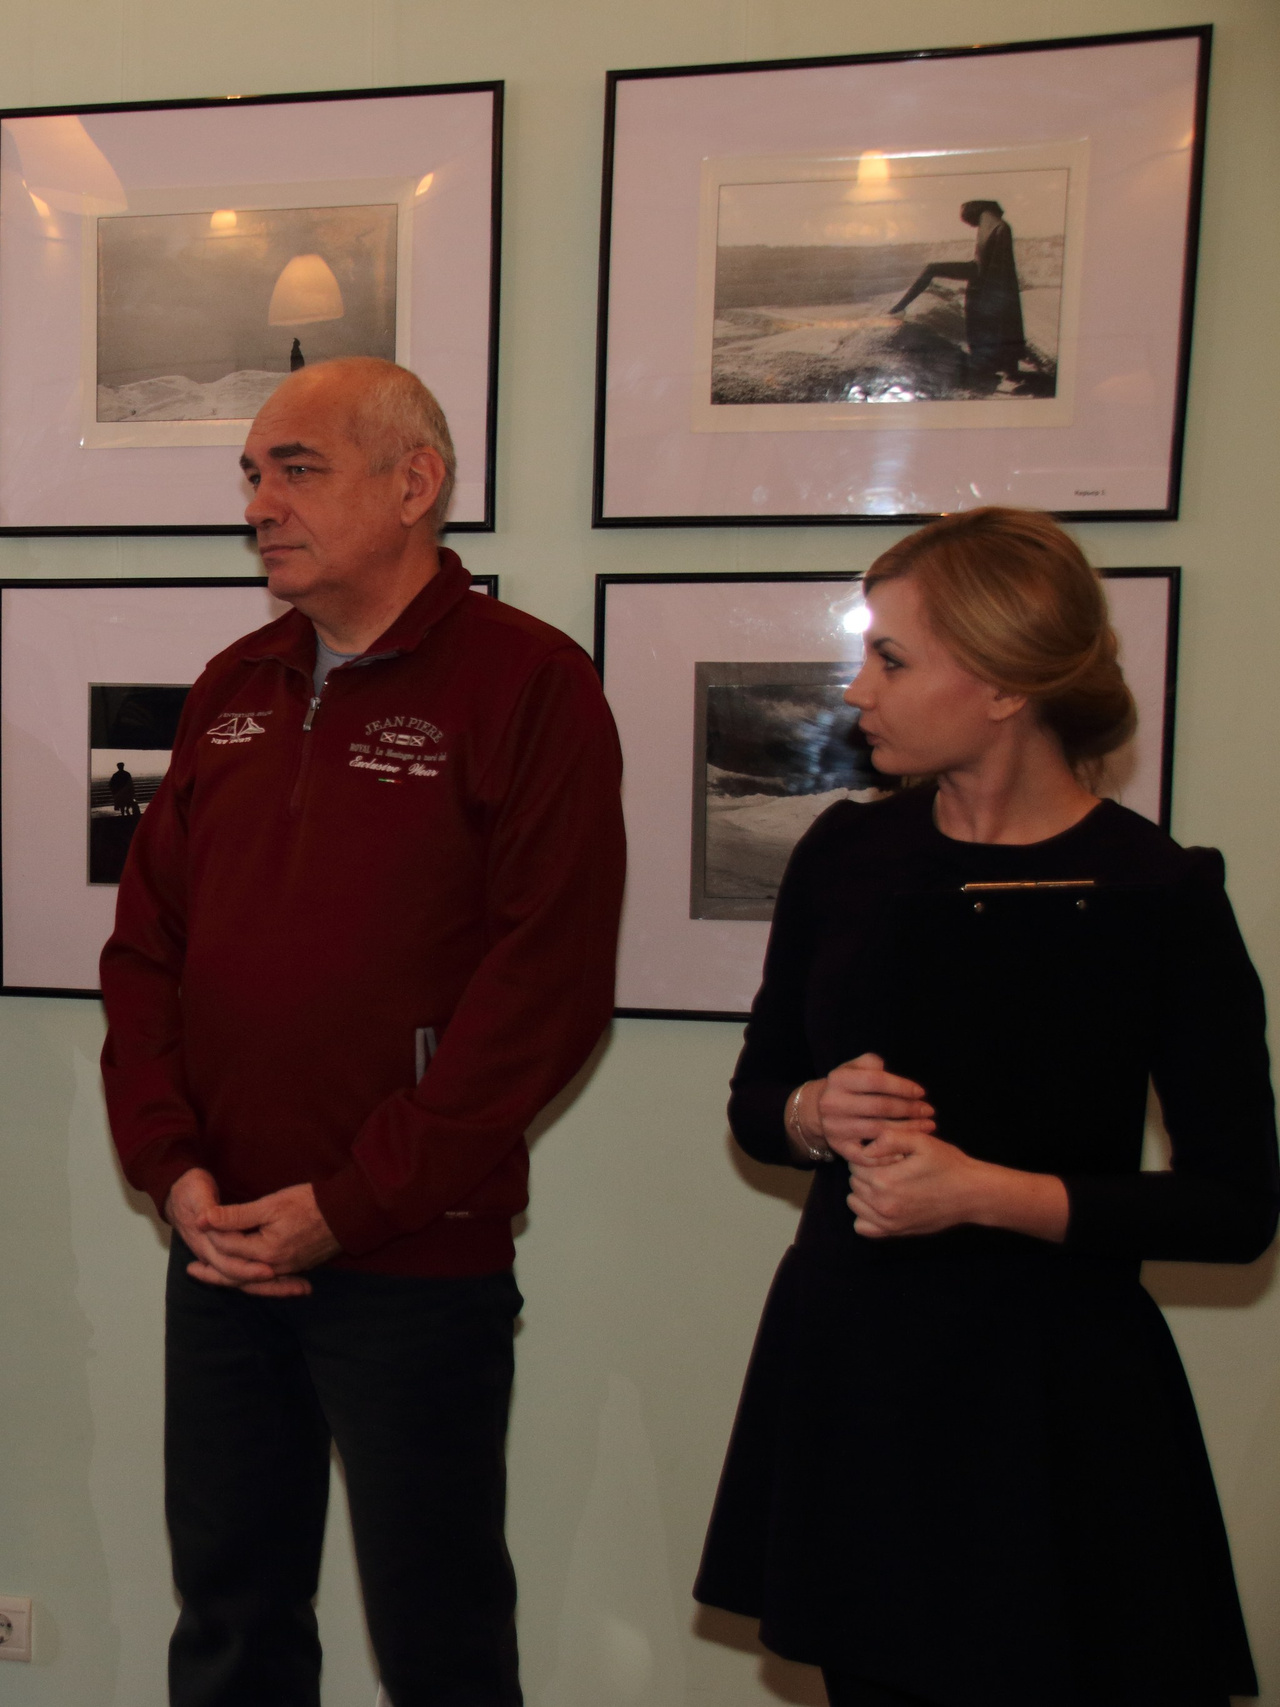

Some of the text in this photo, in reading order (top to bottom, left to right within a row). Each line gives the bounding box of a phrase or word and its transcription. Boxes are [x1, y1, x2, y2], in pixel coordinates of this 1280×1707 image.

[365, 716, 444, 744] JEAN PIERE
[349, 755, 440, 777] Exclusive Wear
